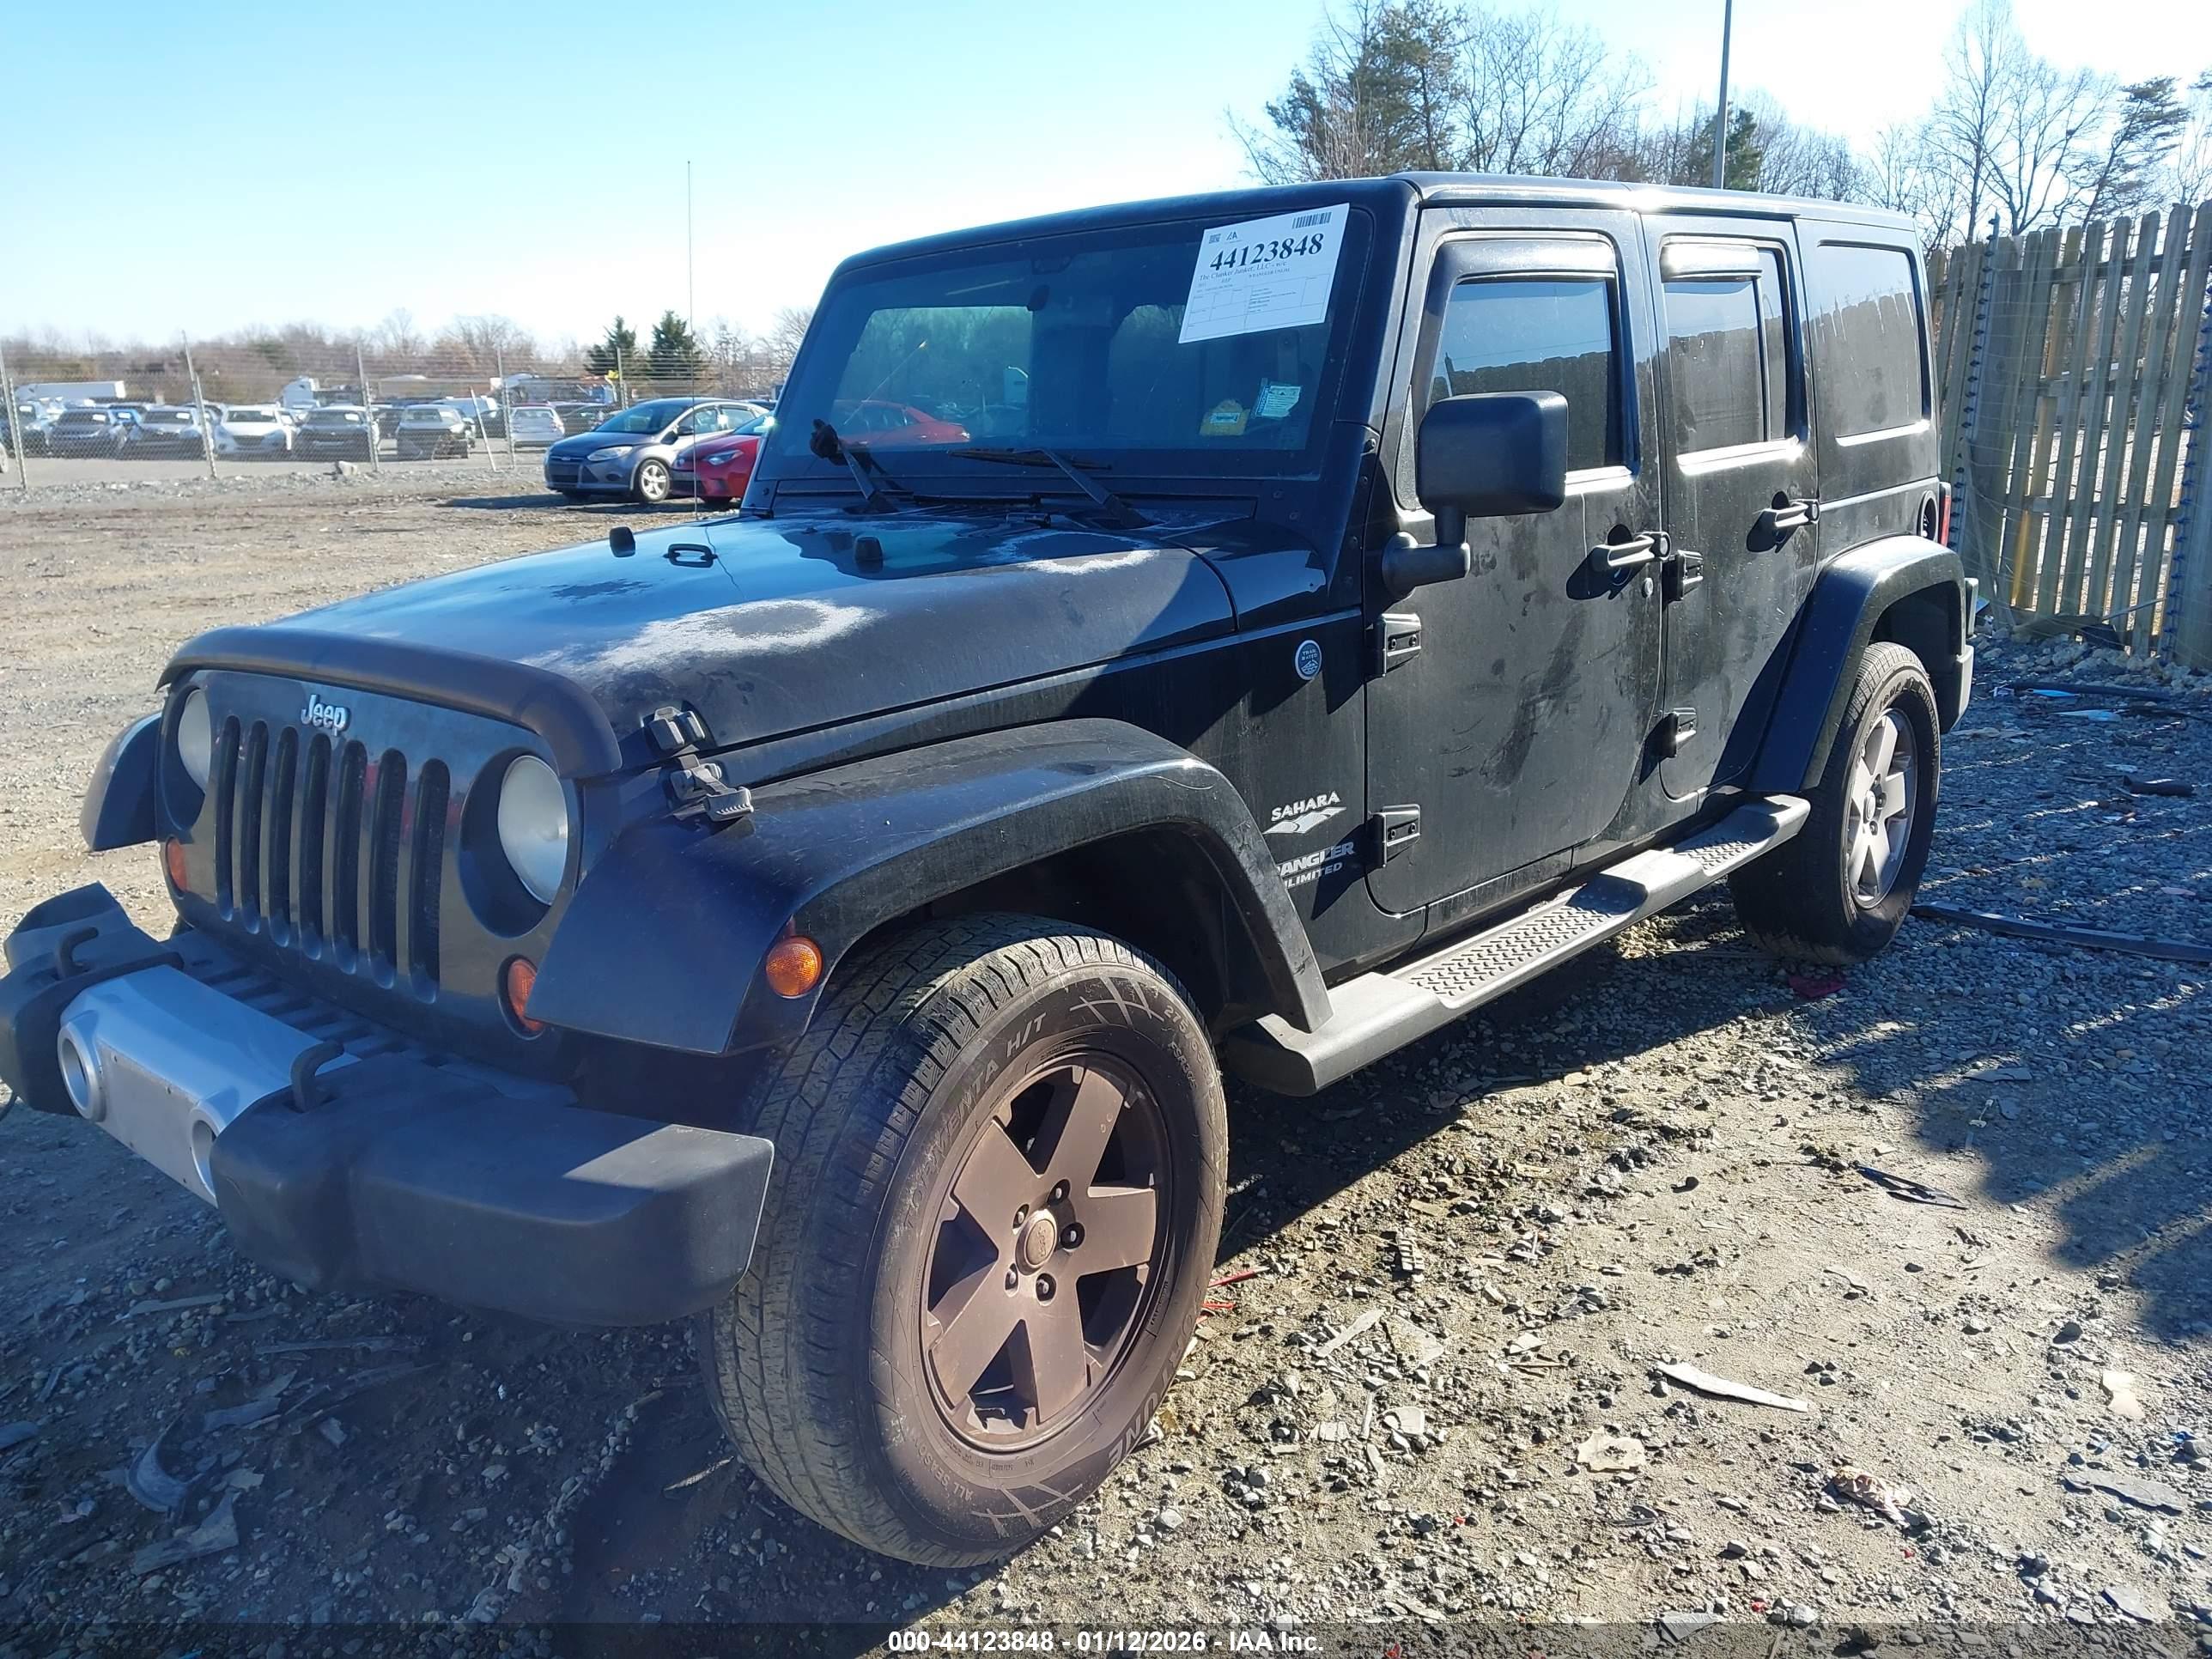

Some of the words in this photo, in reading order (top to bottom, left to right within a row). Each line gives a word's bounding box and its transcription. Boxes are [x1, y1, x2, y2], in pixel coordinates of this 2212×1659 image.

[1209, 233, 1324, 271] 44123848
[301, 694, 349, 737] Jeep
[1271, 791, 1340, 821] SAHARA
[1004, 1011, 1048, 1059] H/T
[949, 1480, 974, 1501] ALL
